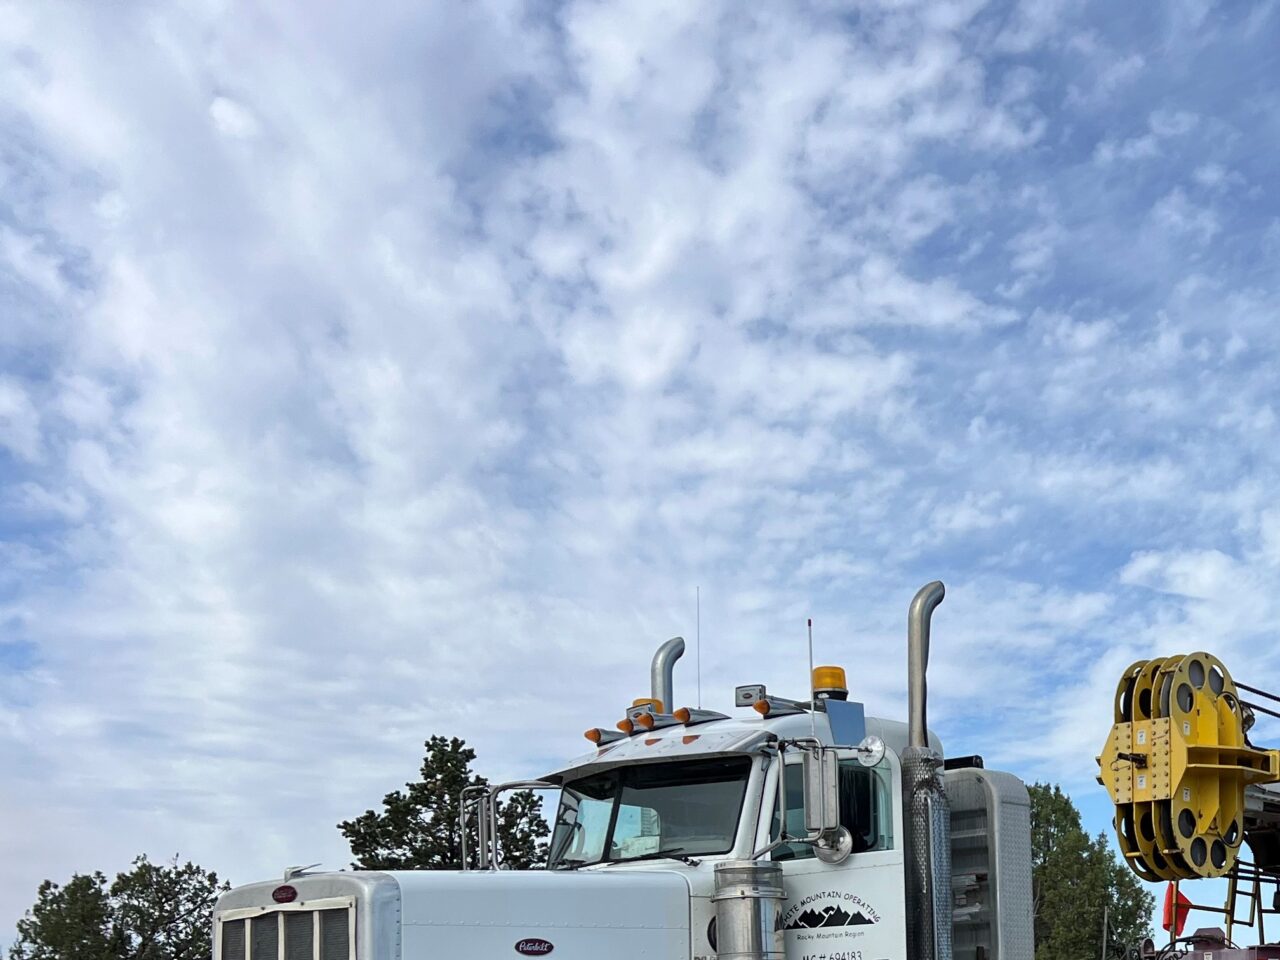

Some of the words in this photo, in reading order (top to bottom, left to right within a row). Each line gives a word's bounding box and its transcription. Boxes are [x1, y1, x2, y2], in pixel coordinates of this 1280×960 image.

[783, 903, 799, 924] HITE
[800, 890, 841, 907] MOUNTAIN
[843, 893, 881, 923] OPERATING
[845, 931, 864, 939] Region
[519, 941, 550, 952] Peterbilt
